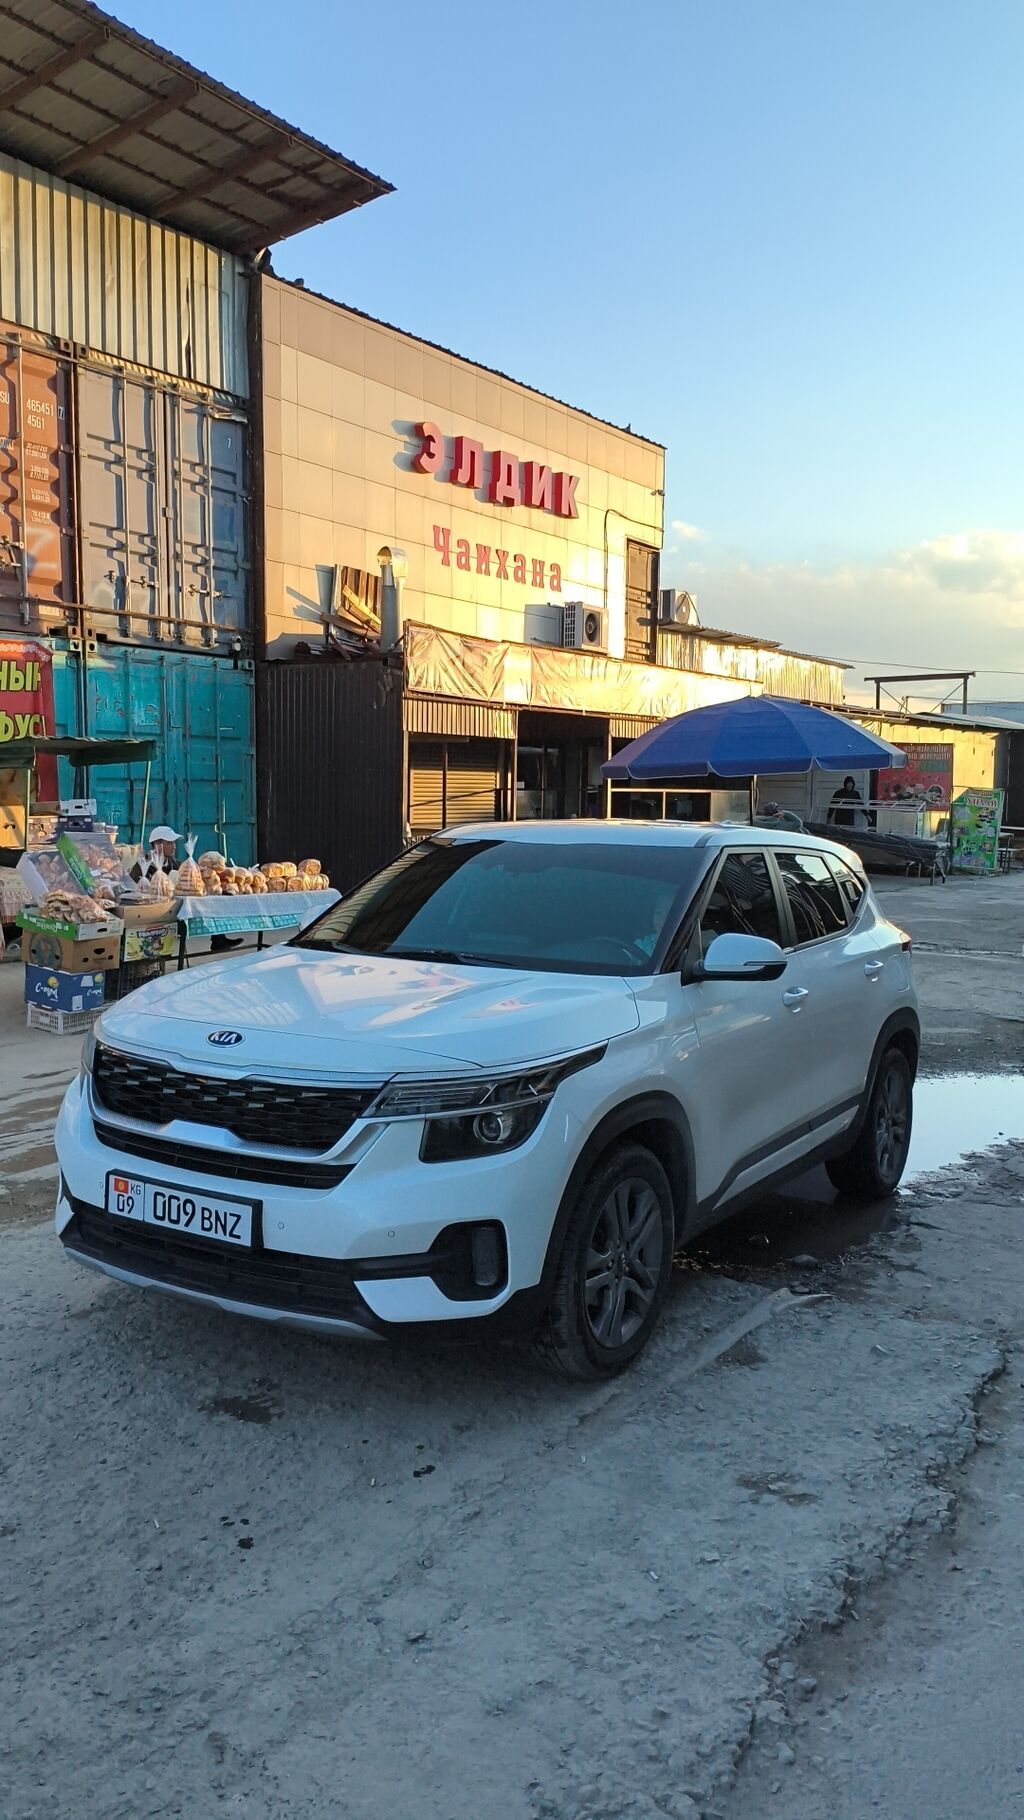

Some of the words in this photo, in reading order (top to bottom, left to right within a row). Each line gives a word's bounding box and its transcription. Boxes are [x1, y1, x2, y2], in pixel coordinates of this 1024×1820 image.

[26, 398, 54, 417] 465451
[26, 414, 45, 430] 45G1
[411, 421, 580, 519] ЭЛДИК
[210, 1031, 237, 1044] KIA
[130, 1184, 141, 1195] KG
[117, 1193, 134, 1214] 09
[153, 1191, 196, 1227] 009
[201, 1206, 242, 1239] BNZ
